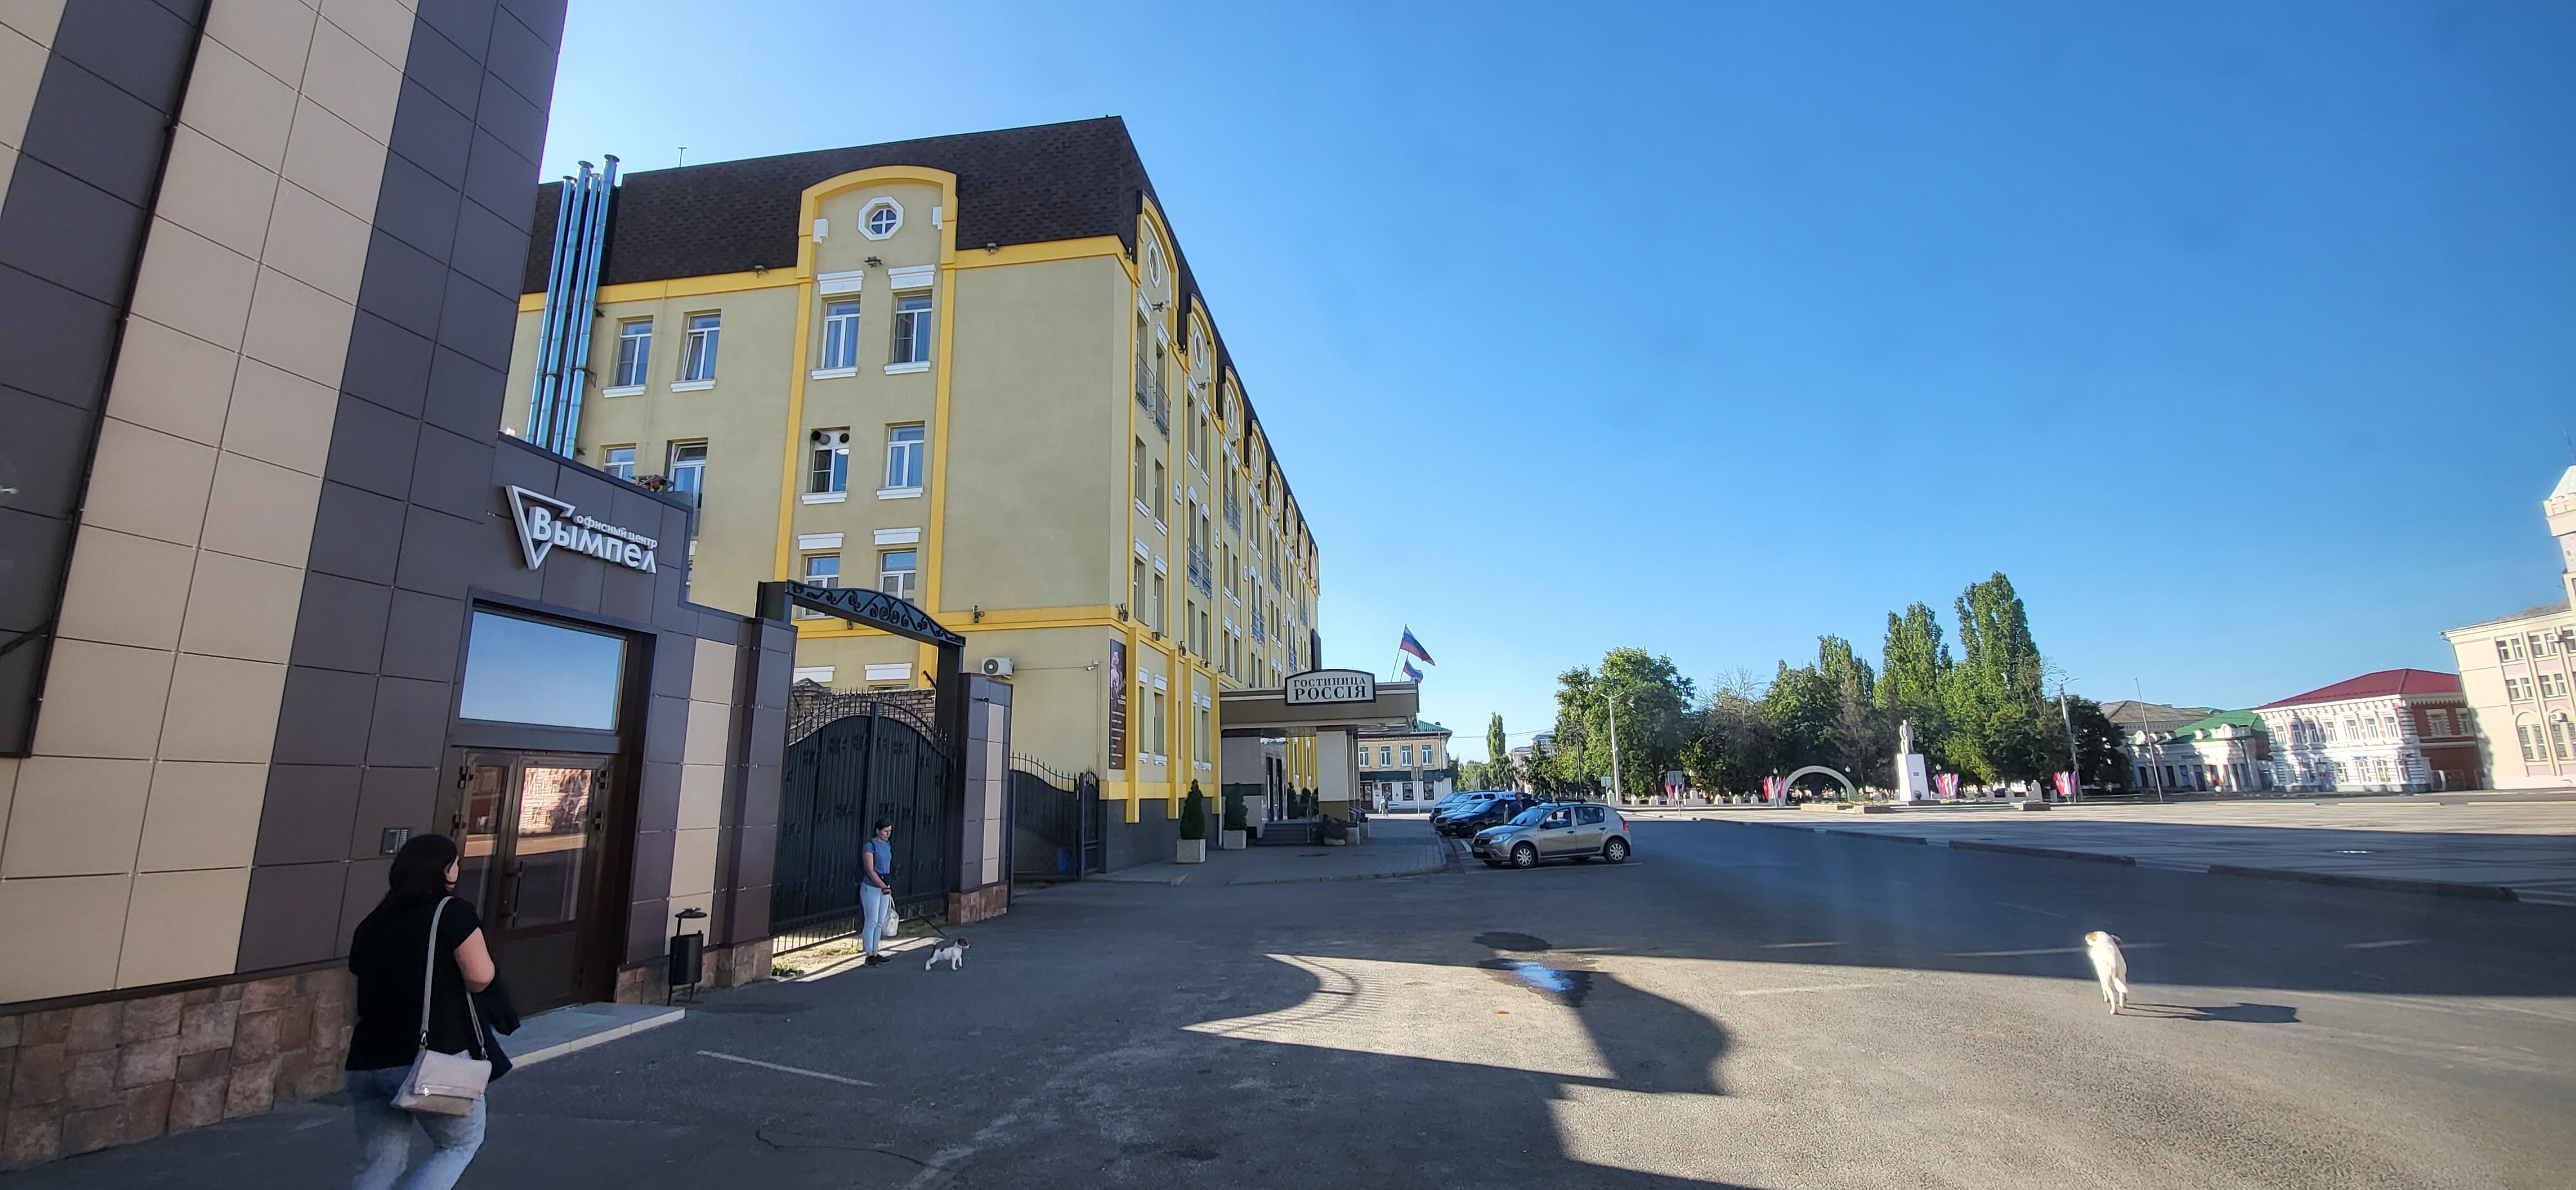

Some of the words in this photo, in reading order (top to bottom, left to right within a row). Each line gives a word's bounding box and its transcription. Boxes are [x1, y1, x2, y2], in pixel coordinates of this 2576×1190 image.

[530, 506, 657, 574] Вымпел
[576, 515, 627, 538] офисный
[628, 532, 658, 549] центр
[1293, 677, 1367, 688] ГОСТИНИЦА
[1293, 685, 1367, 701] РОССІЯ
